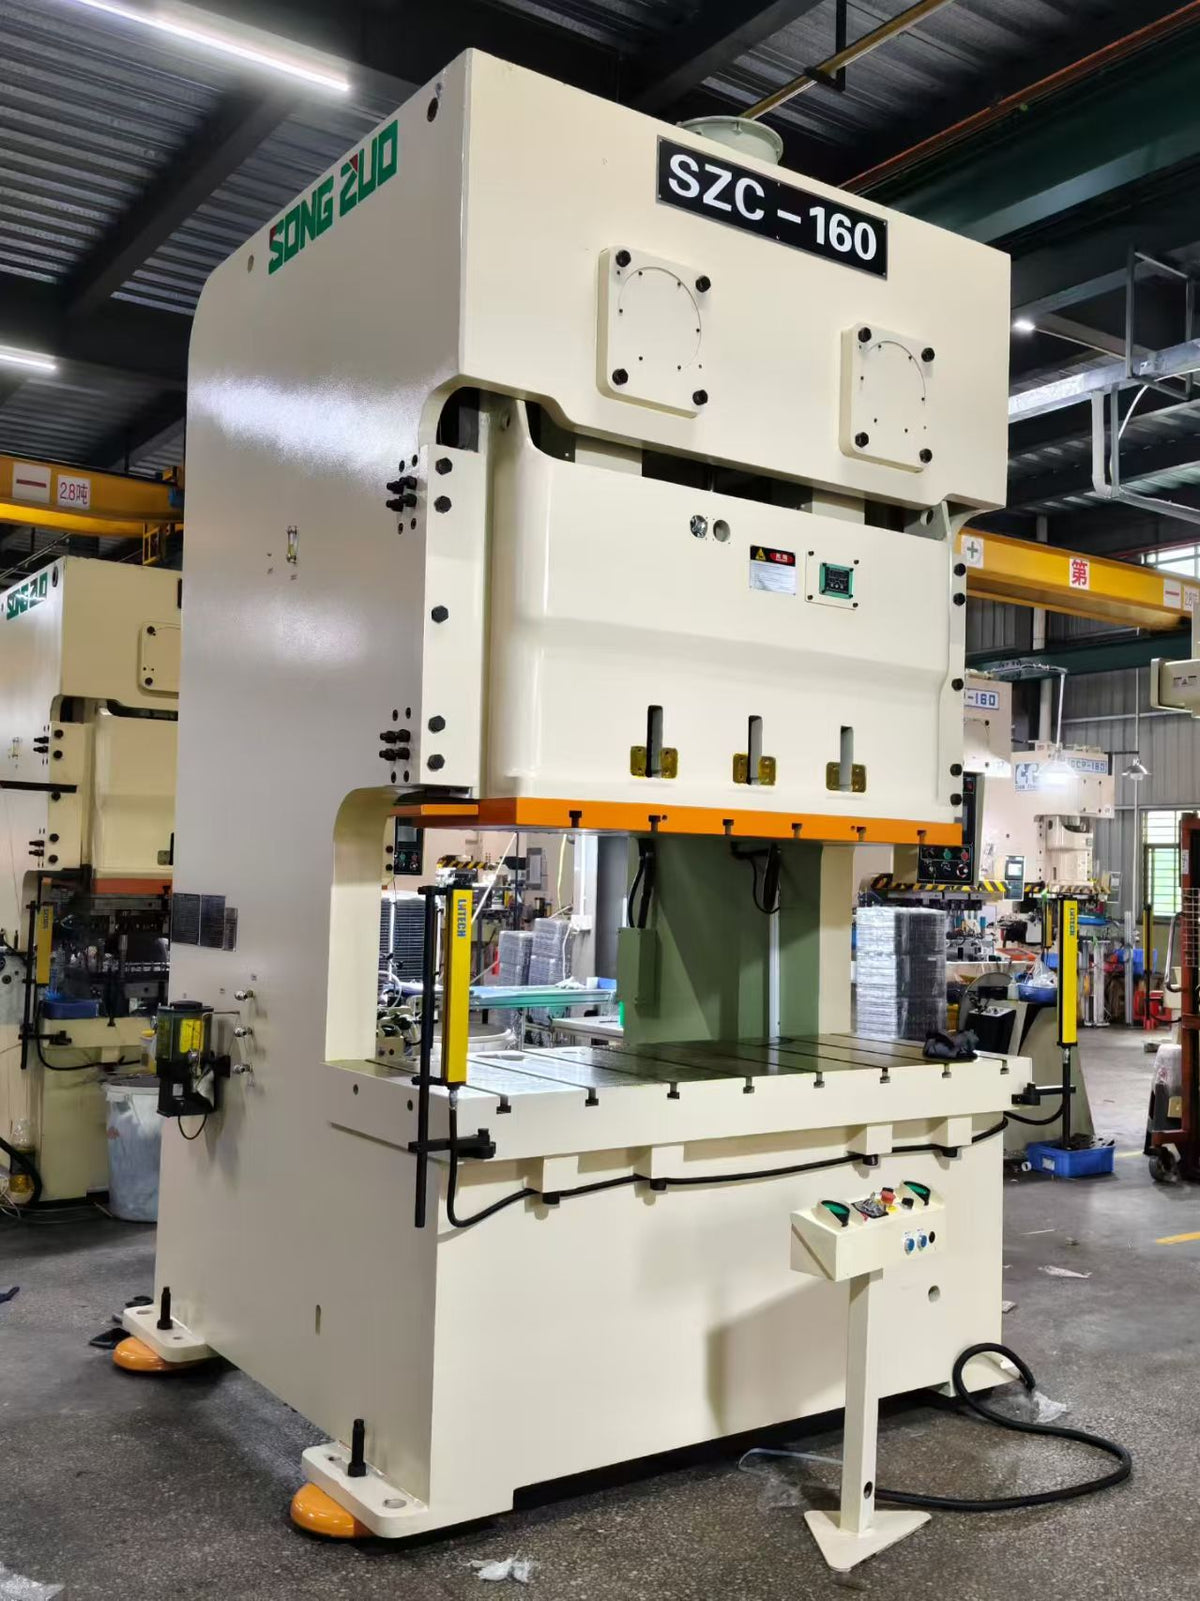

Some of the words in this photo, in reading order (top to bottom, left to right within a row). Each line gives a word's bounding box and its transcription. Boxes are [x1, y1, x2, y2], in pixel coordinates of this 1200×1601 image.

[268, 175, 334, 275] SONG
[339, 119, 399, 218] ZUO
[1071, 559, 1088, 586] 第
